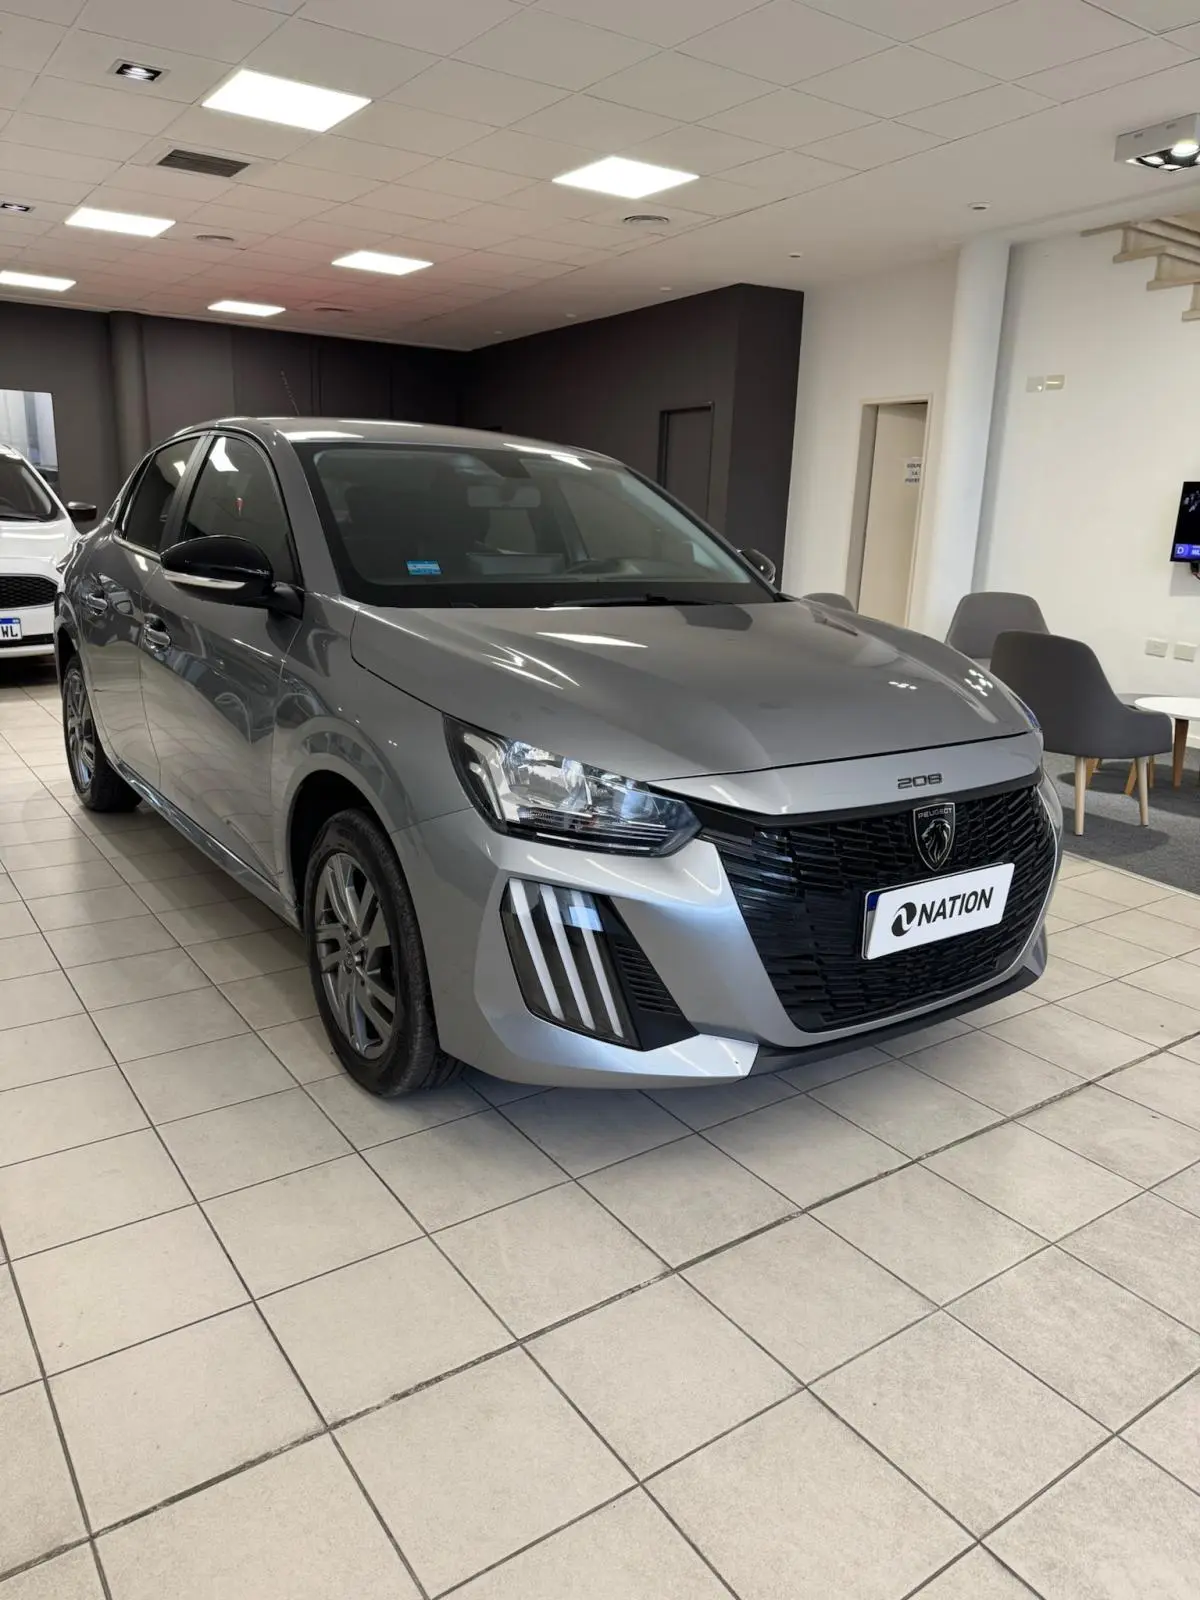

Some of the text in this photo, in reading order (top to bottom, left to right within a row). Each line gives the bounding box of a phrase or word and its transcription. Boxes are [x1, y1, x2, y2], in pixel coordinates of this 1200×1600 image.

[1, 625, 18, 638] WL
[897, 773, 943, 790] 208
[918, 807, 952, 819] PEUGEOT
[917, 886, 994, 927] NATION
